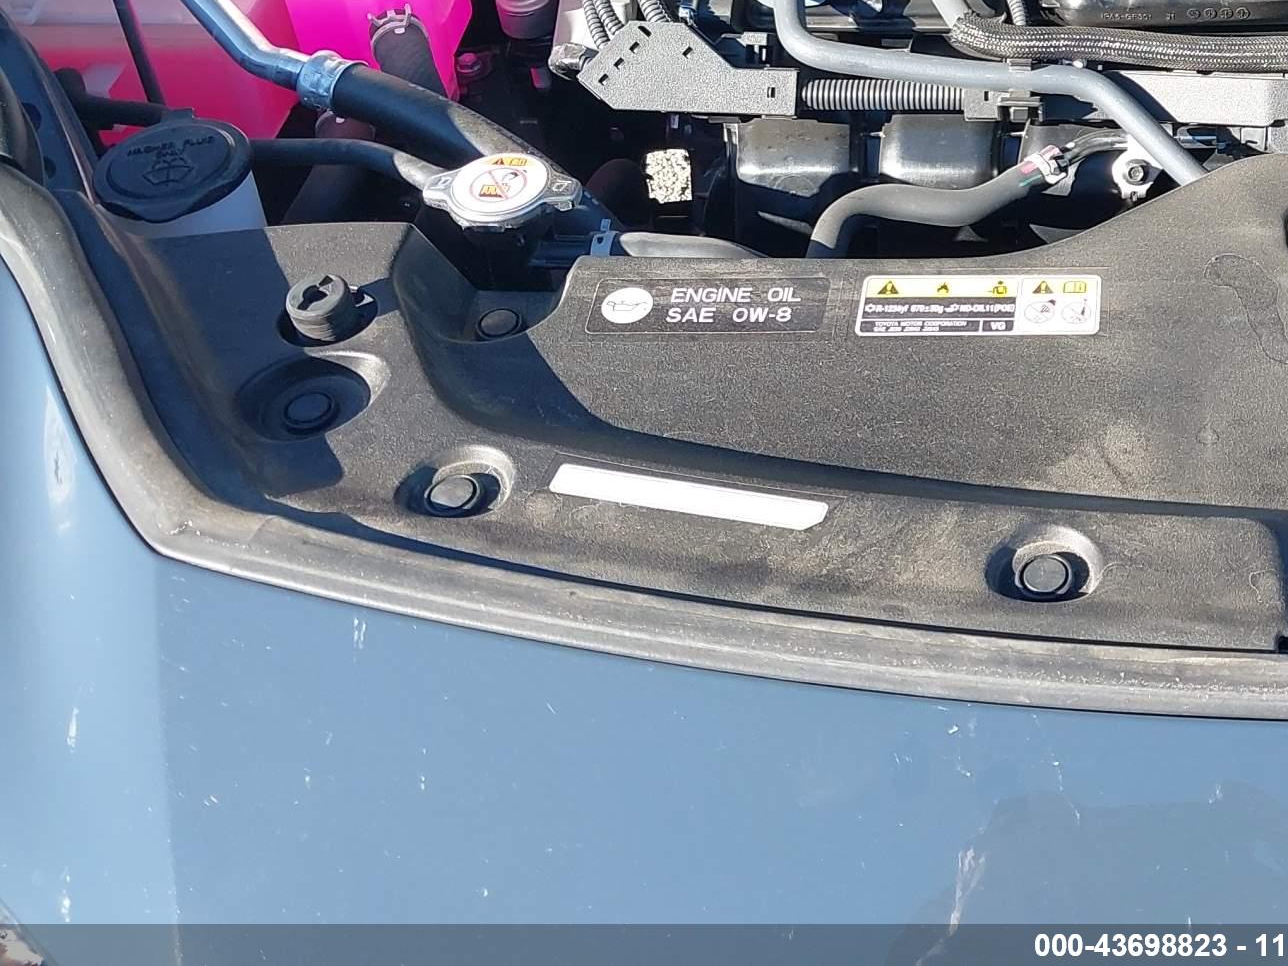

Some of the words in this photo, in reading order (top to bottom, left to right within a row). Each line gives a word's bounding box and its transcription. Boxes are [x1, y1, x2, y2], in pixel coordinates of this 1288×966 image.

[670, 286, 754, 304] ENGINE
[766, 286, 802, 304] OIL
[665, 306, 717, 324] SAE
